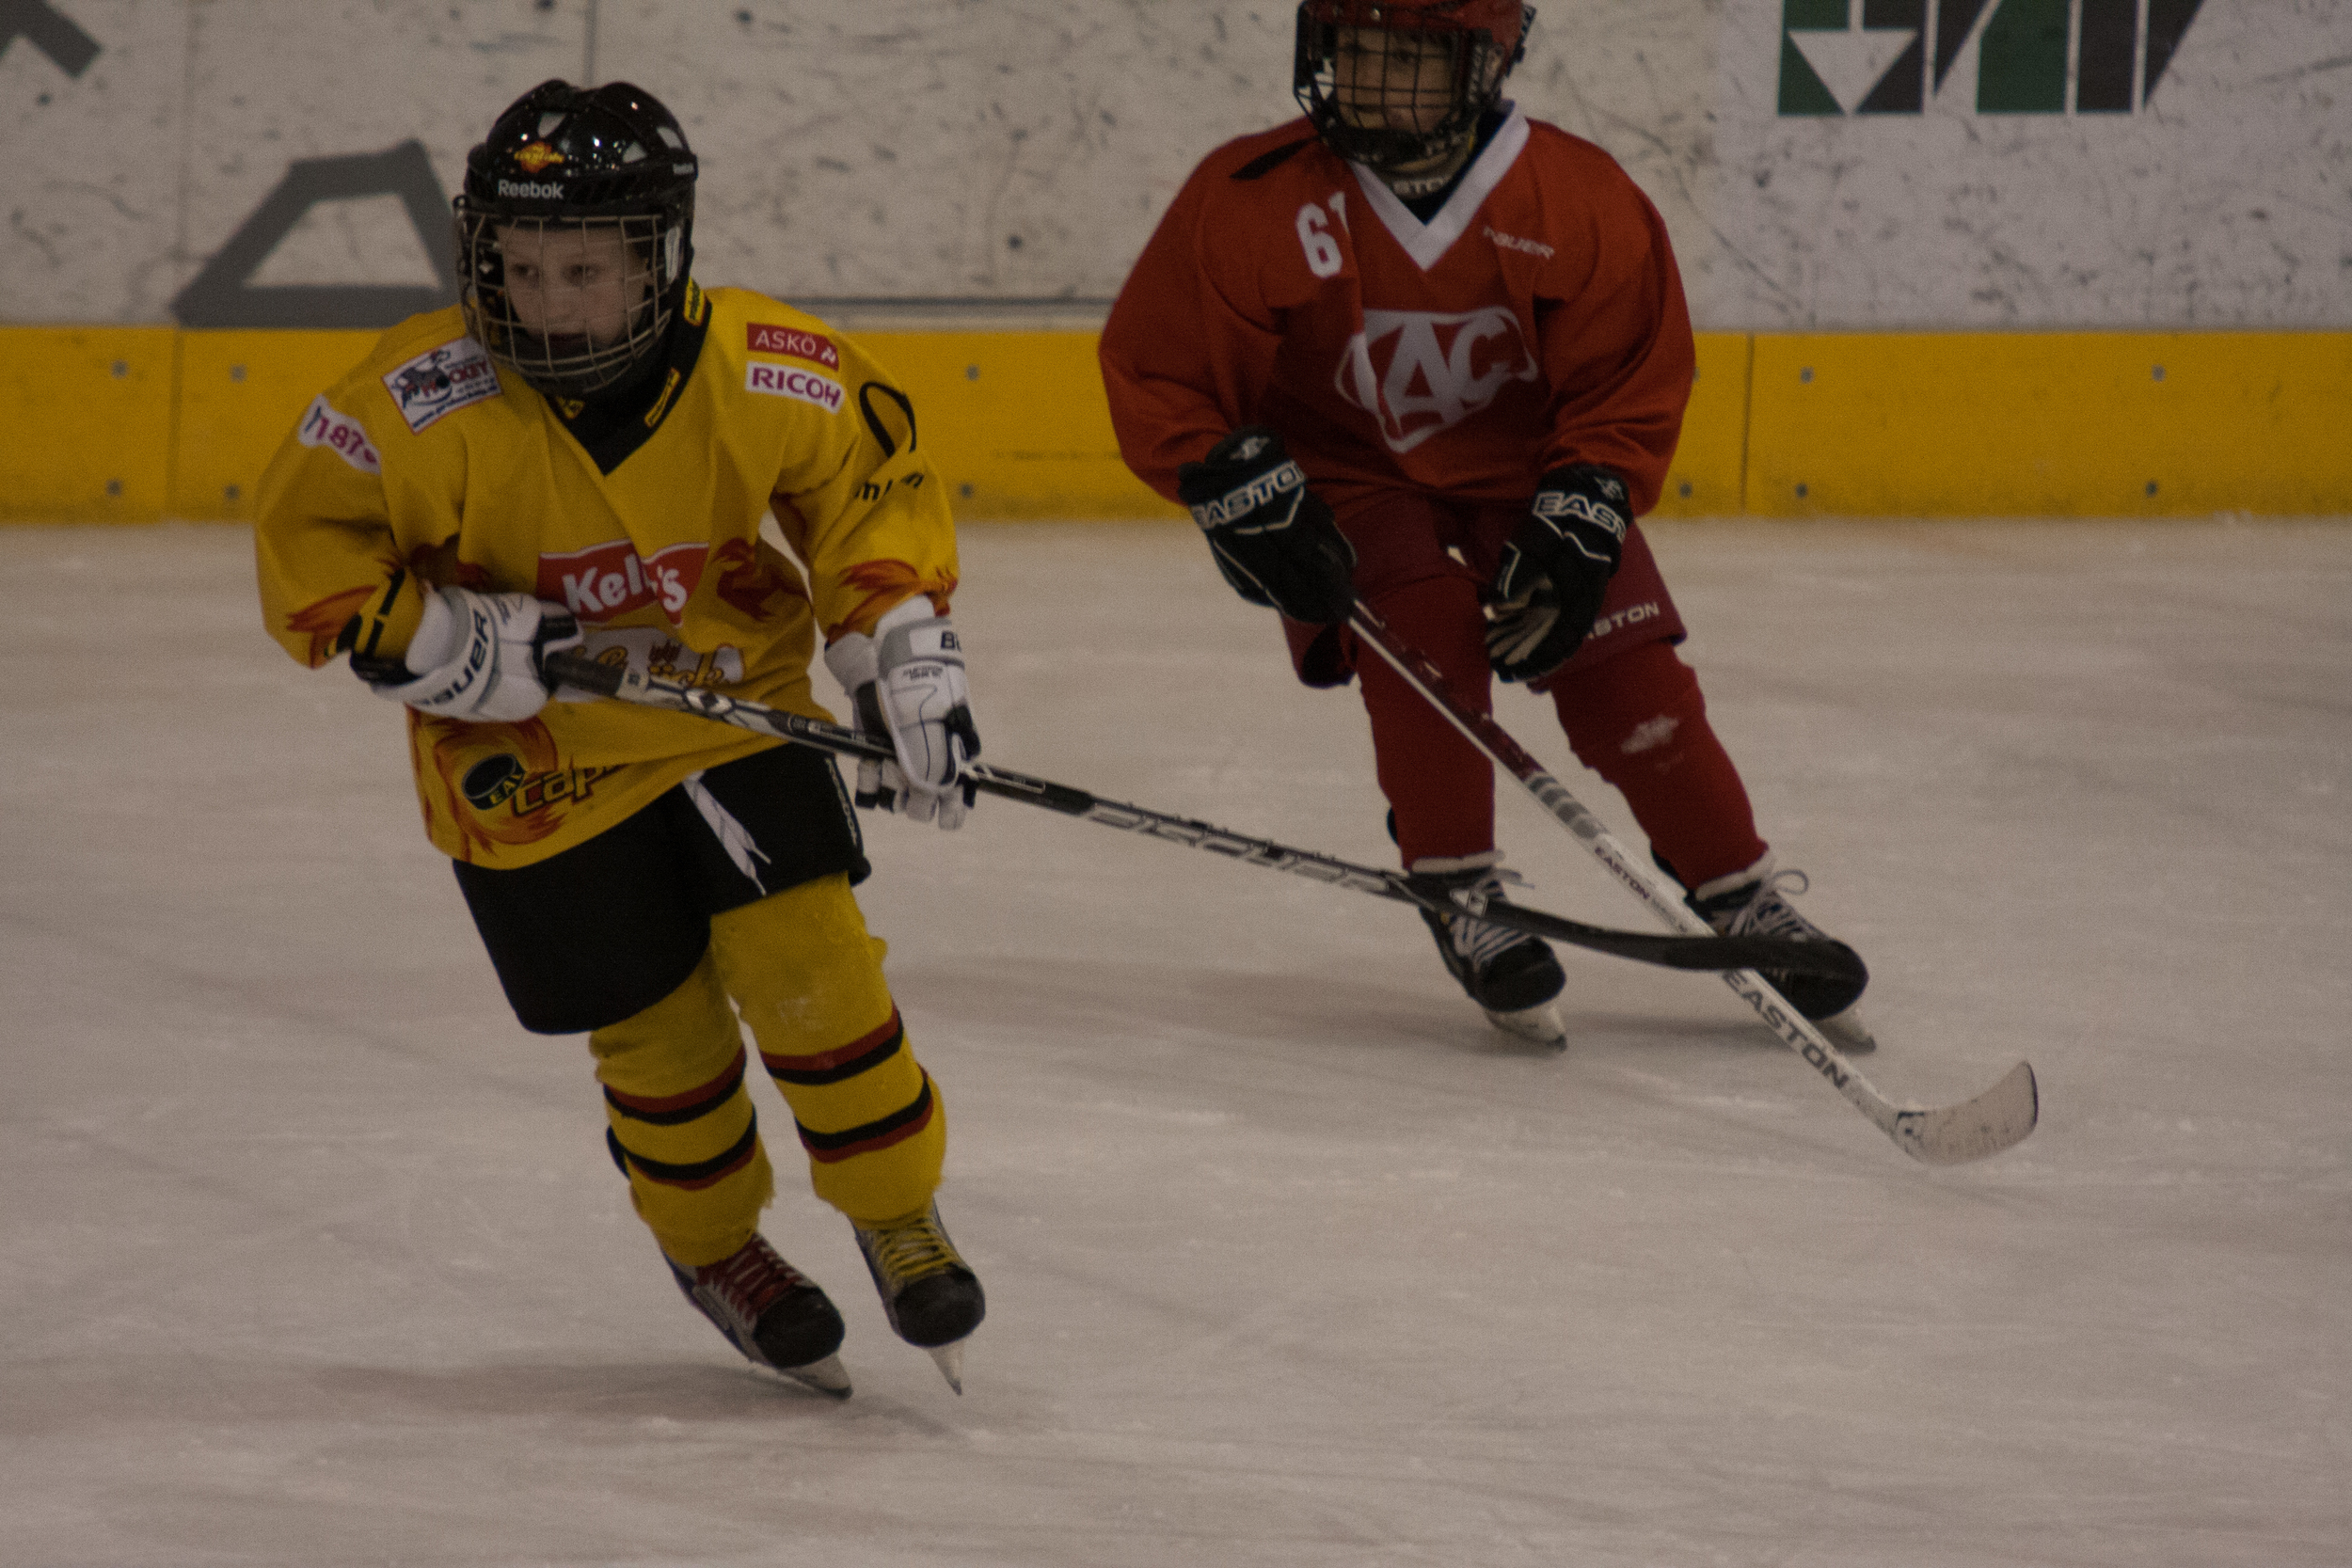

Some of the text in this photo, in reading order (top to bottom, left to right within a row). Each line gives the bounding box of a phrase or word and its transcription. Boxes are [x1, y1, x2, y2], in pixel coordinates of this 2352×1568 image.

[498, 178, 564, 199] Reebok
[755, 329, 816, 356] ASKÖ
[752, 367, 840, 407] RICOH
[1722, 970, 1849, 1089] EASTON
